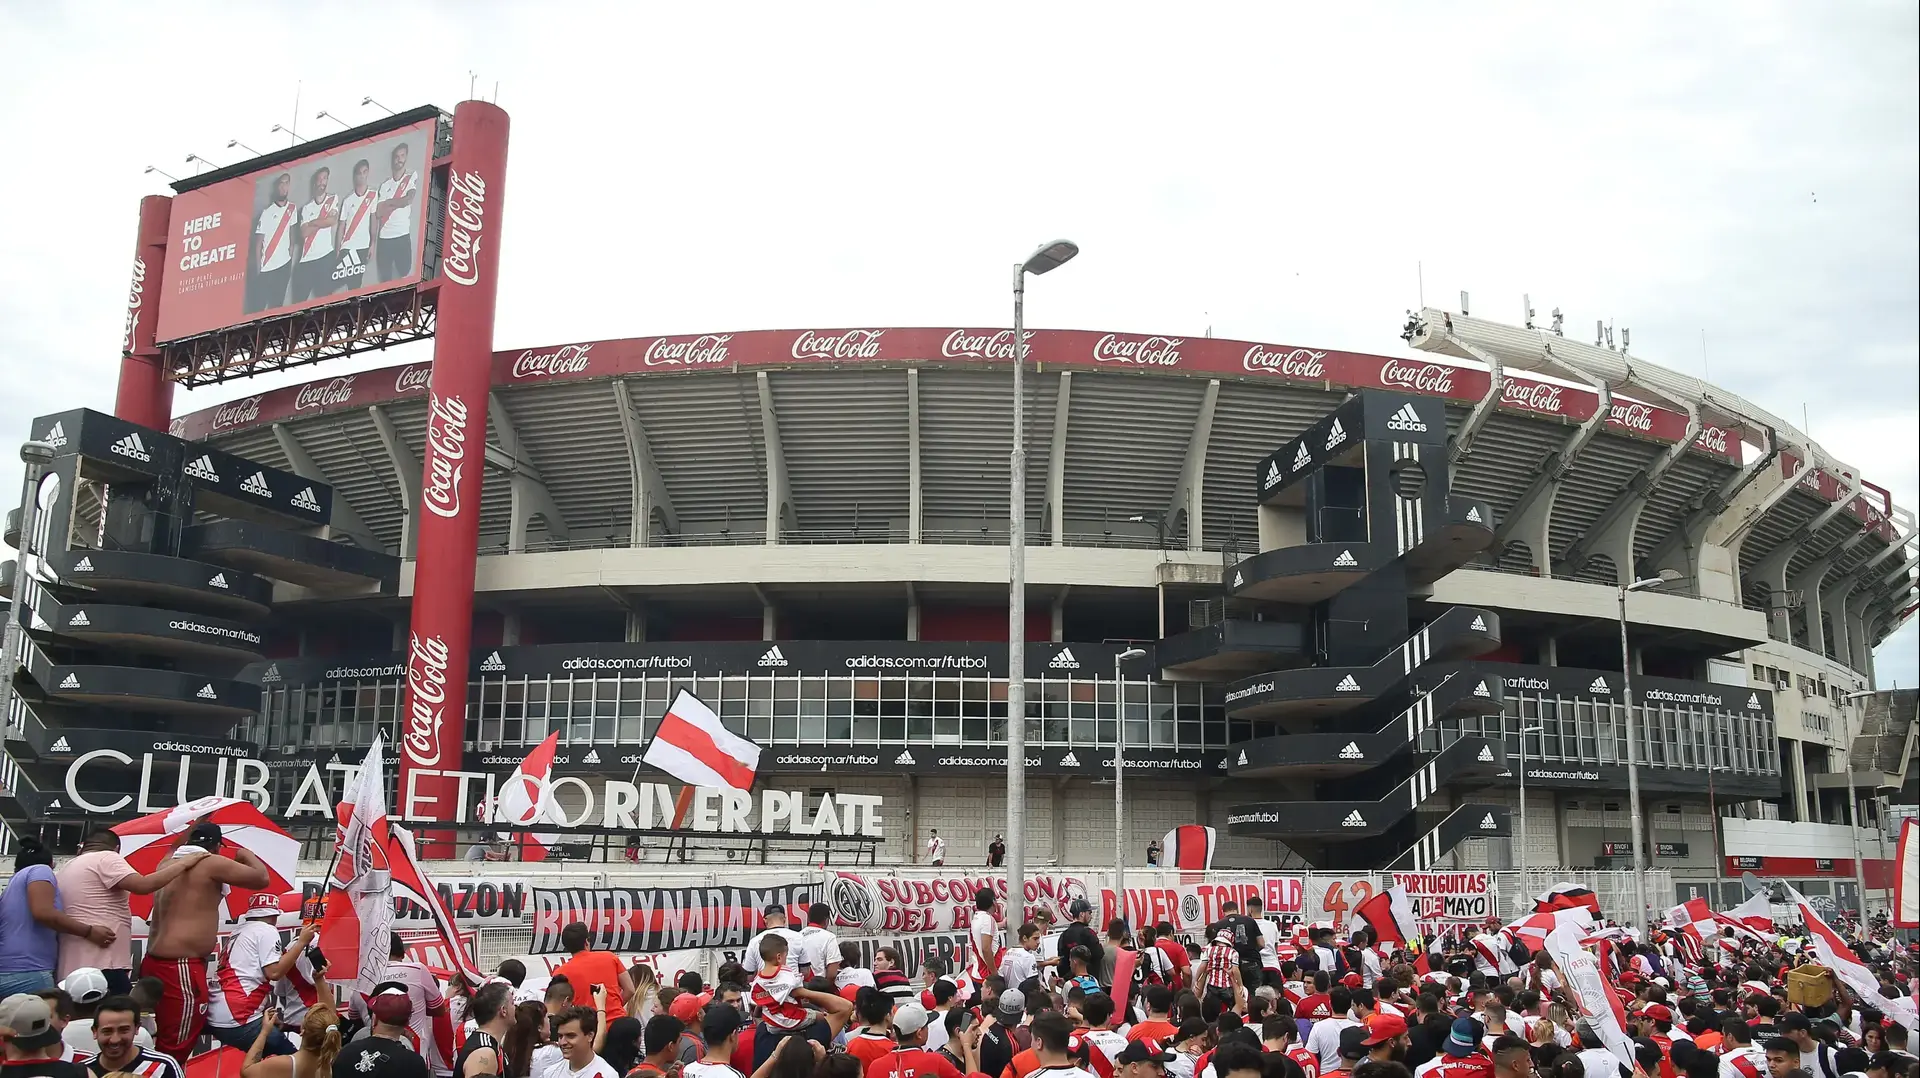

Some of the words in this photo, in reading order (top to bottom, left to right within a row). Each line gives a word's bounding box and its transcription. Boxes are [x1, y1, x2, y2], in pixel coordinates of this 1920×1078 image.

[183, 212, 221, 235] HERE
[442, 168, 487, 286] Coca-Cola
[182, 235, 203, 253] TO
[180, 243, 236, 271] CREATE
[332, 263, 366, 281] adidas
[644, 334, 735, 367] Coca-Cola
[791, 328, 886, 359] Coca-Cola
[1093, 333, 1186, 367] Coca-Cola
[512, 342, 595, 378] Coca-Cola
[1243, 344, 1328, 379] Coca-Cola
[395, 364, 433, 392] Coca-
[1380, 358, 1456, 394] Coca-Cola
[295, 377, 354, 410] Coca-Cola
[212, 396, 263, 430] Coca-Cola
[1605, 402, 1654, 432] ca-Cola
[1387, 420, 1427, 433] adidas
[1325, 431, 1347, 452] adidas
[110, 444, 150, 463] adidas
[423, 392, 469, 518] Coca-Cola
[1292, 449, 1312, 473] adidas
[184, 466, 220, 484] adidas
[1264, 470, 1282, 490] adidas
[239, 481, 273, 499] adidas
[290, 497, 321, 513] adidas
[1466, 514, 1482, 523] adidas
[73, 563, 95, 573] adidas
[1333, 558, 1358, 567] adidas
[208, 580, 229, 590] adidas
[69, 618, 91, 627] adidas
[1470, 623, 1487, 632] adidas
[169, 620, 261, 645] adidas.com.ar/futbol
[480, 661, 506, 672] adidas
[562, 655, 692, 670] adidas.com.ar/futbol
[757, 657, 788, 668] adidas
[845, 655, 987, 670] adidas.com.ar/futbol
[1049, 659, 1080, 670] adidas
[261, 672, 283, 683] adidas
[325, 664, 408, 680] adidas.com.ar/fu
[59, 681, 81, 690] adidas
[1336, 683, 1361, 693] adidas
[1473, 688, 1491, 698] adidas
[1589, 686, 1611, 695] adidas
[196, 691, 217, 700] adidas
[403, 630, 449, 767] Coca-Cola
[1646, 690, 1722, 707] adidas.com.ar/futbol
[1747, 702, 1762, 711] adidas
[50, 743, 72, 753] adidas
[153, 740, 249, 758] adidas.com.ar/futbol
[1339, 751, 1364, 760] adidas
[776, 754, 879, 766] adidas.com.ar/futbol
[895, 758, 916, 766] adidas
[1060, 759, 1080, 767] adidas
[1477, 753, 1494, 762] adidas
[1527, 769, 1599, 781] adidas.com.ar/futbol
[65, 749, 272, 814] CLUB
[284, 761, 596, 828] ATETICO
[604, 780, 753, 834] RIVER
[761, 789, 884, 837] PLATE
[1342, 819, 1367, 828] adidas
[1480, 821, 1497, 830] adidas
[1605, 844, 1613, 854] Y
[876, 876, 1055, 904] SUBCOMISON
[1393, 873, 1487, 894] TORTUGUITAS
[1423, 896, 1443, 917] DE
[1444, 896, 1485, 916] MAYO
[532, 890, 633, 954] RIVER
[633, 890, 656, 949] Y
[661, 888, 744, 949] NADA
[885, 907, 939, 933] DEL
[381, 972, 407, 982] rancés
